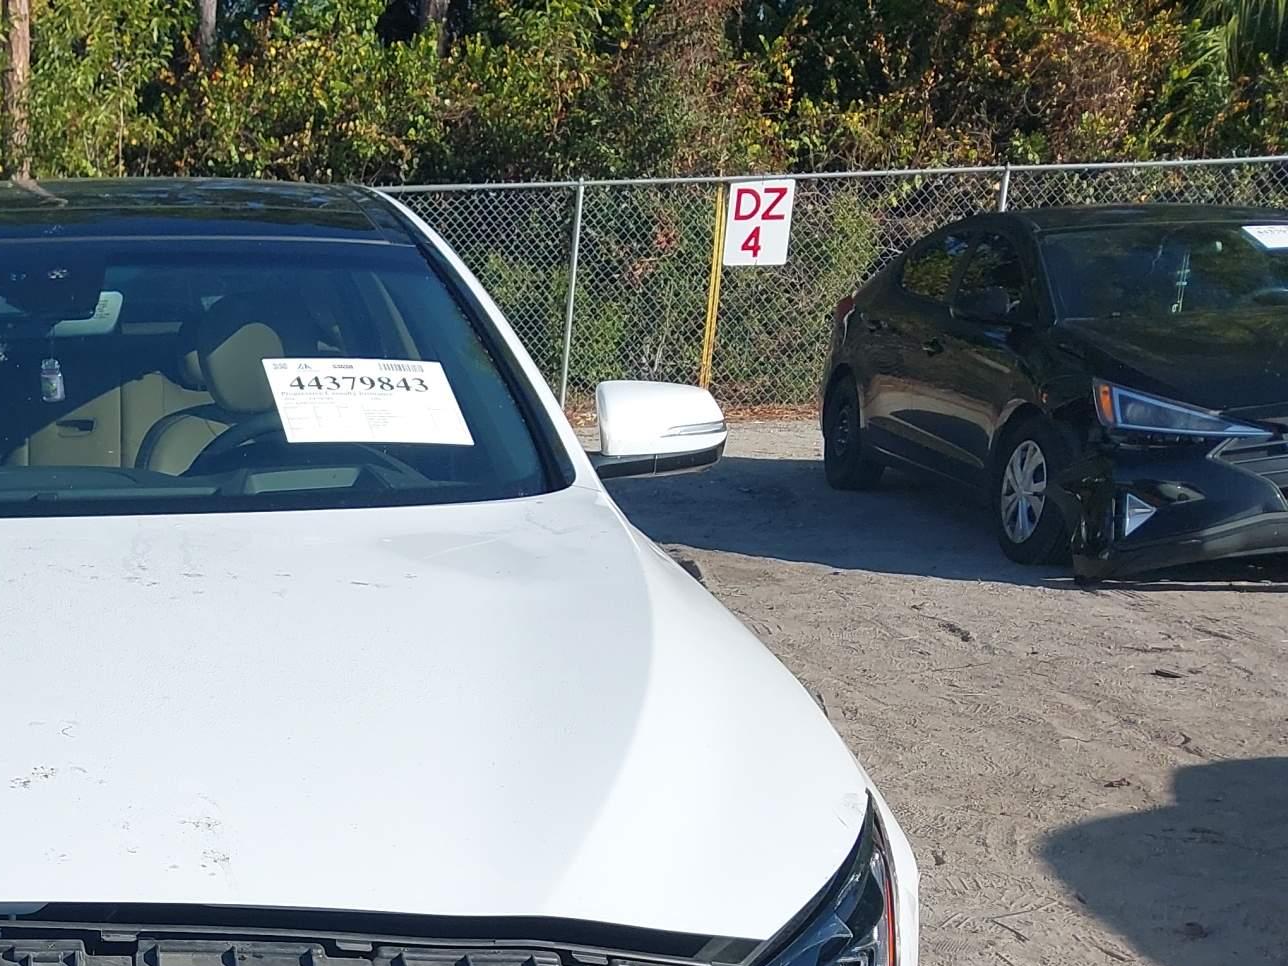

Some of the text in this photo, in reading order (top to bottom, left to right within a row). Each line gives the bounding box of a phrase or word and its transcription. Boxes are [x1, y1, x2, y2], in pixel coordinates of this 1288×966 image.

[734, 187, 788, 220] DZ
[741, 226, 761, 257] 4
[289, 375, 429, 393] 44379843
